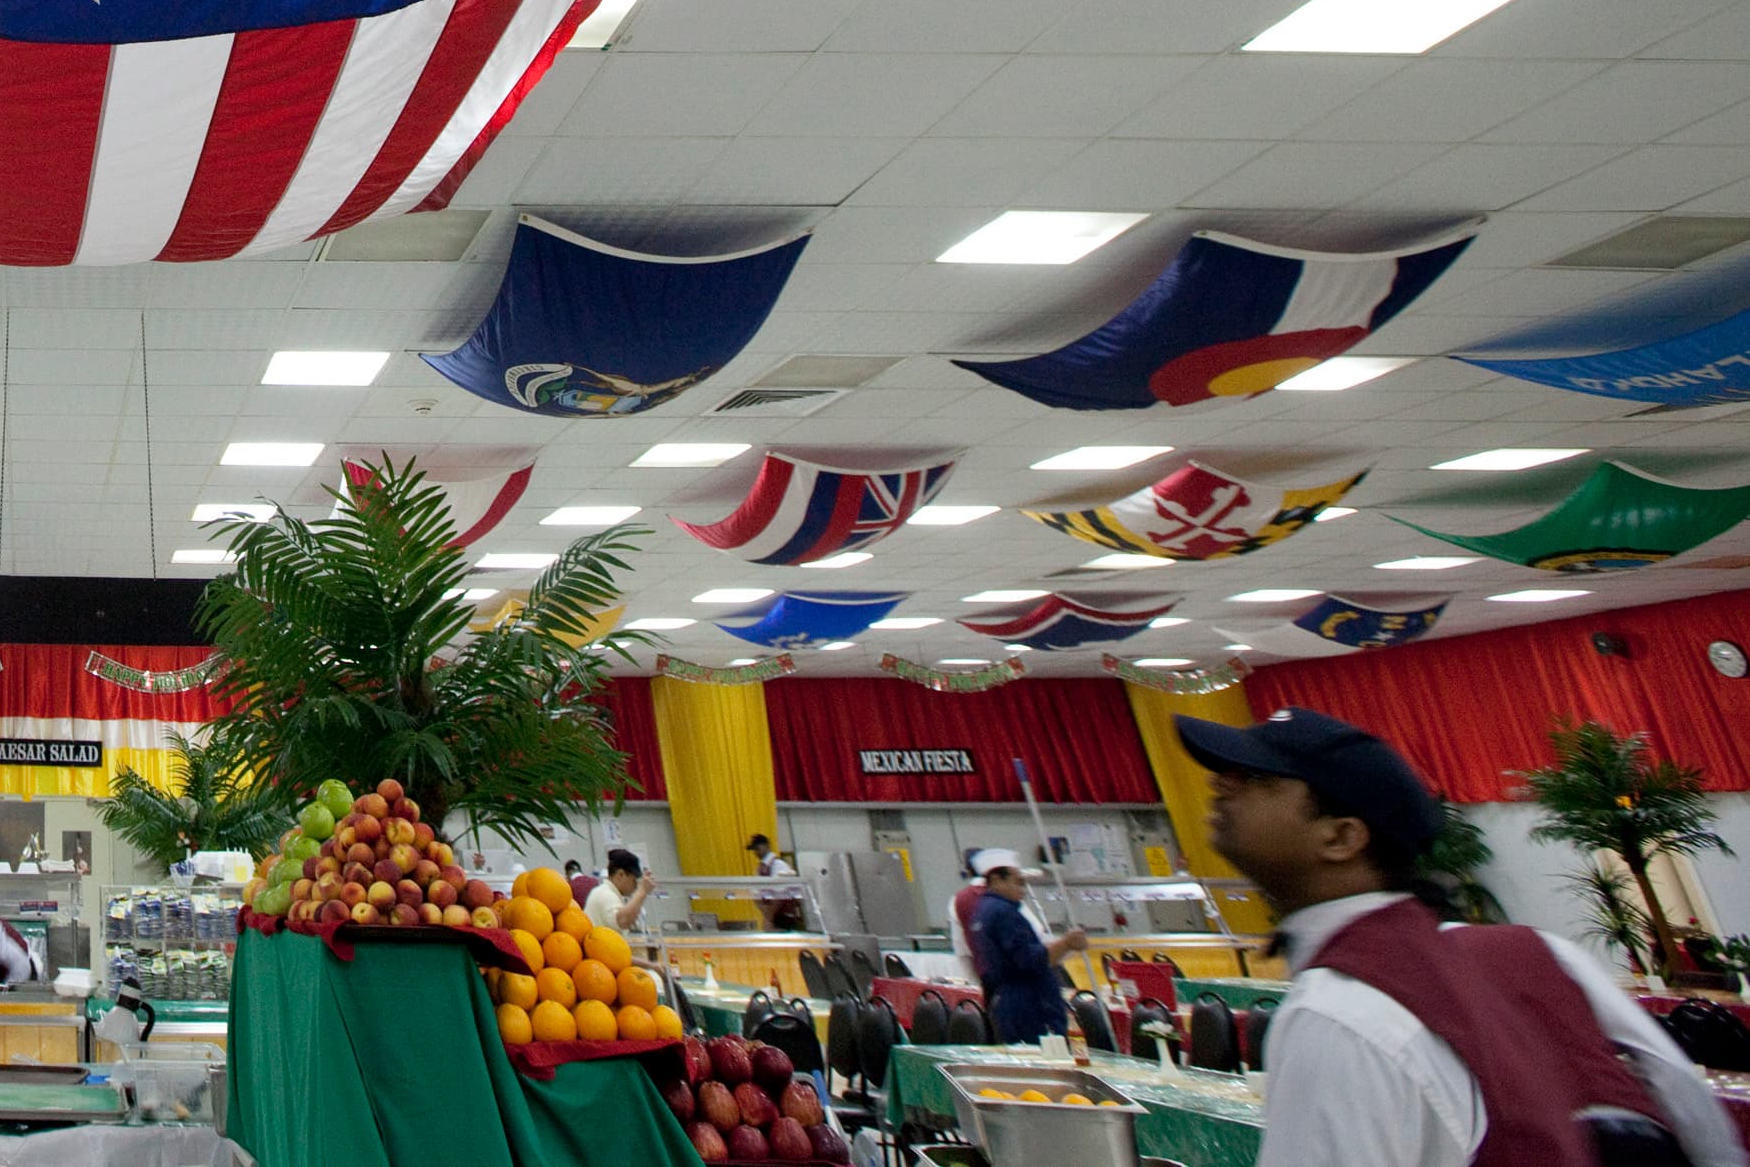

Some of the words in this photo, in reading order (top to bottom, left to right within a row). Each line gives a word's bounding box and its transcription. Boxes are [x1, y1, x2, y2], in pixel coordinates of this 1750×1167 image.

[103, 661, 148, 687] HAPPY
[49, 744, 99, 763] SALAD
[859, 750, 924, 773] MEXICAN
[921, 750, 974, 772] FIESTA
